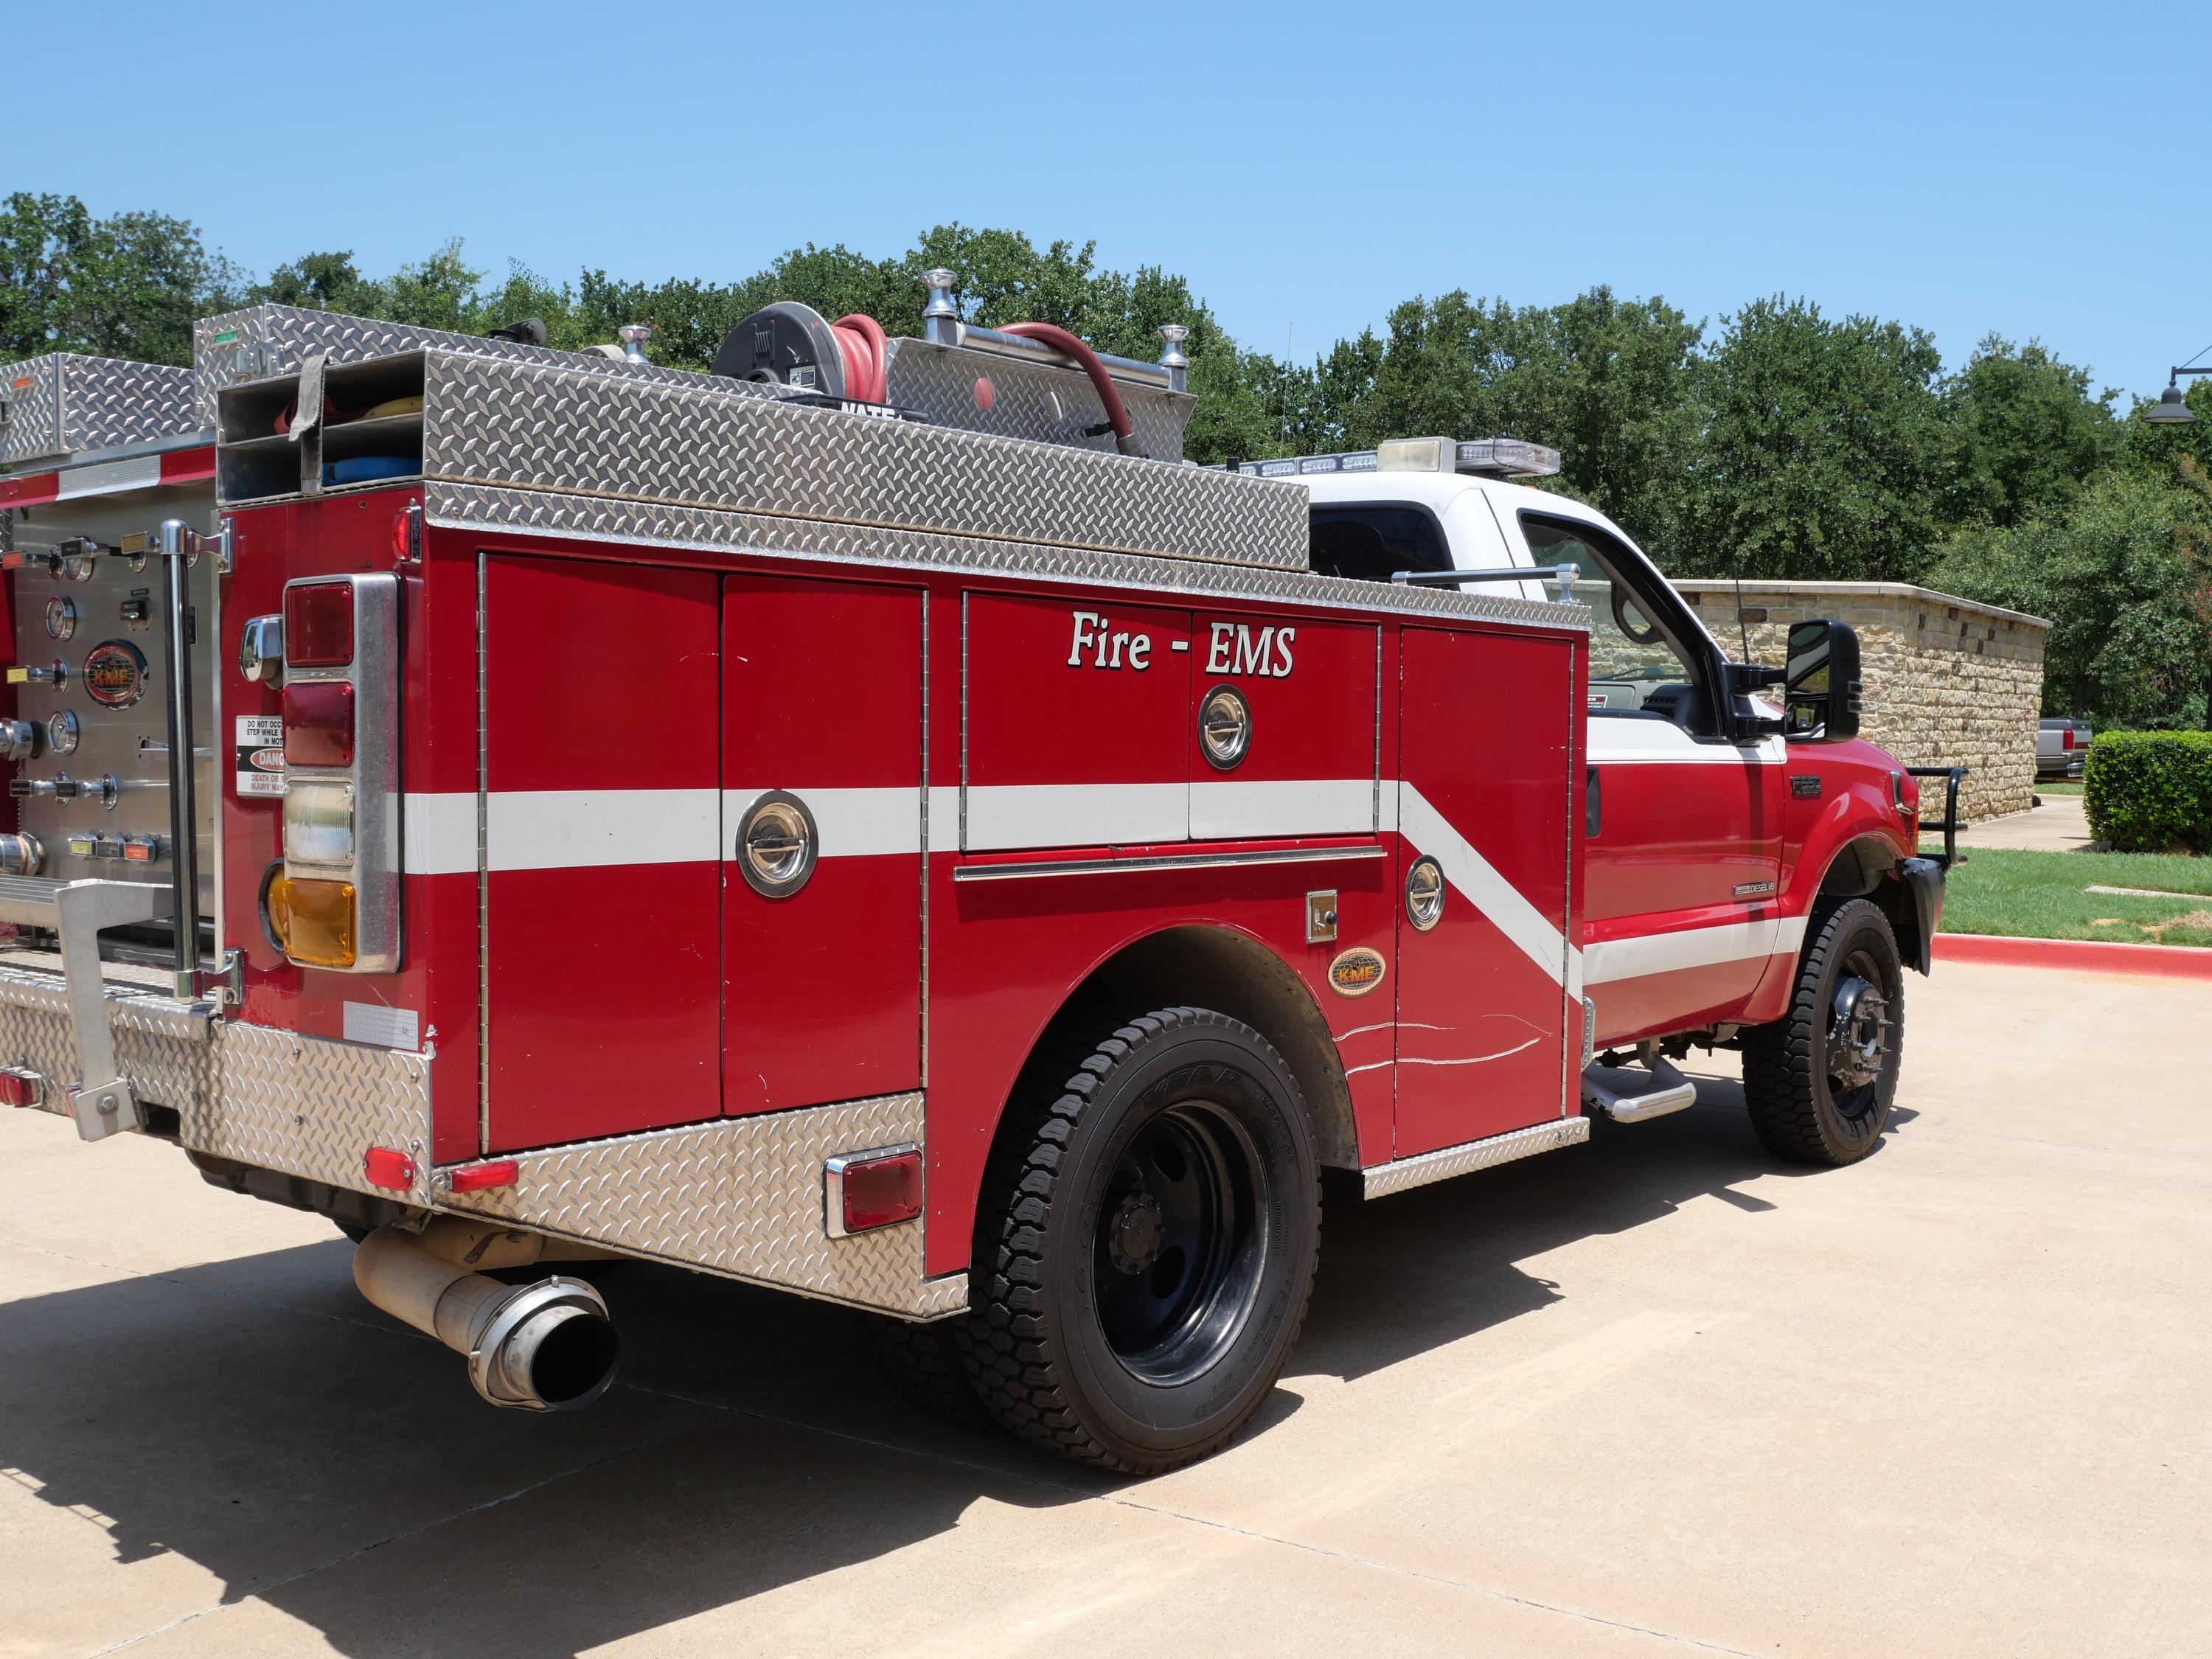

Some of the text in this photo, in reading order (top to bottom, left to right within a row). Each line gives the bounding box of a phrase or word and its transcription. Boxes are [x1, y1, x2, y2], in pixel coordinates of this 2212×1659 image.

[1068, 611, 1295, 677] Fire - EMS
[94, 667, 130, 686] KME
[1750, 883, 1768, 893] DIESEL
[1338, 966, 1375, 984] KME
